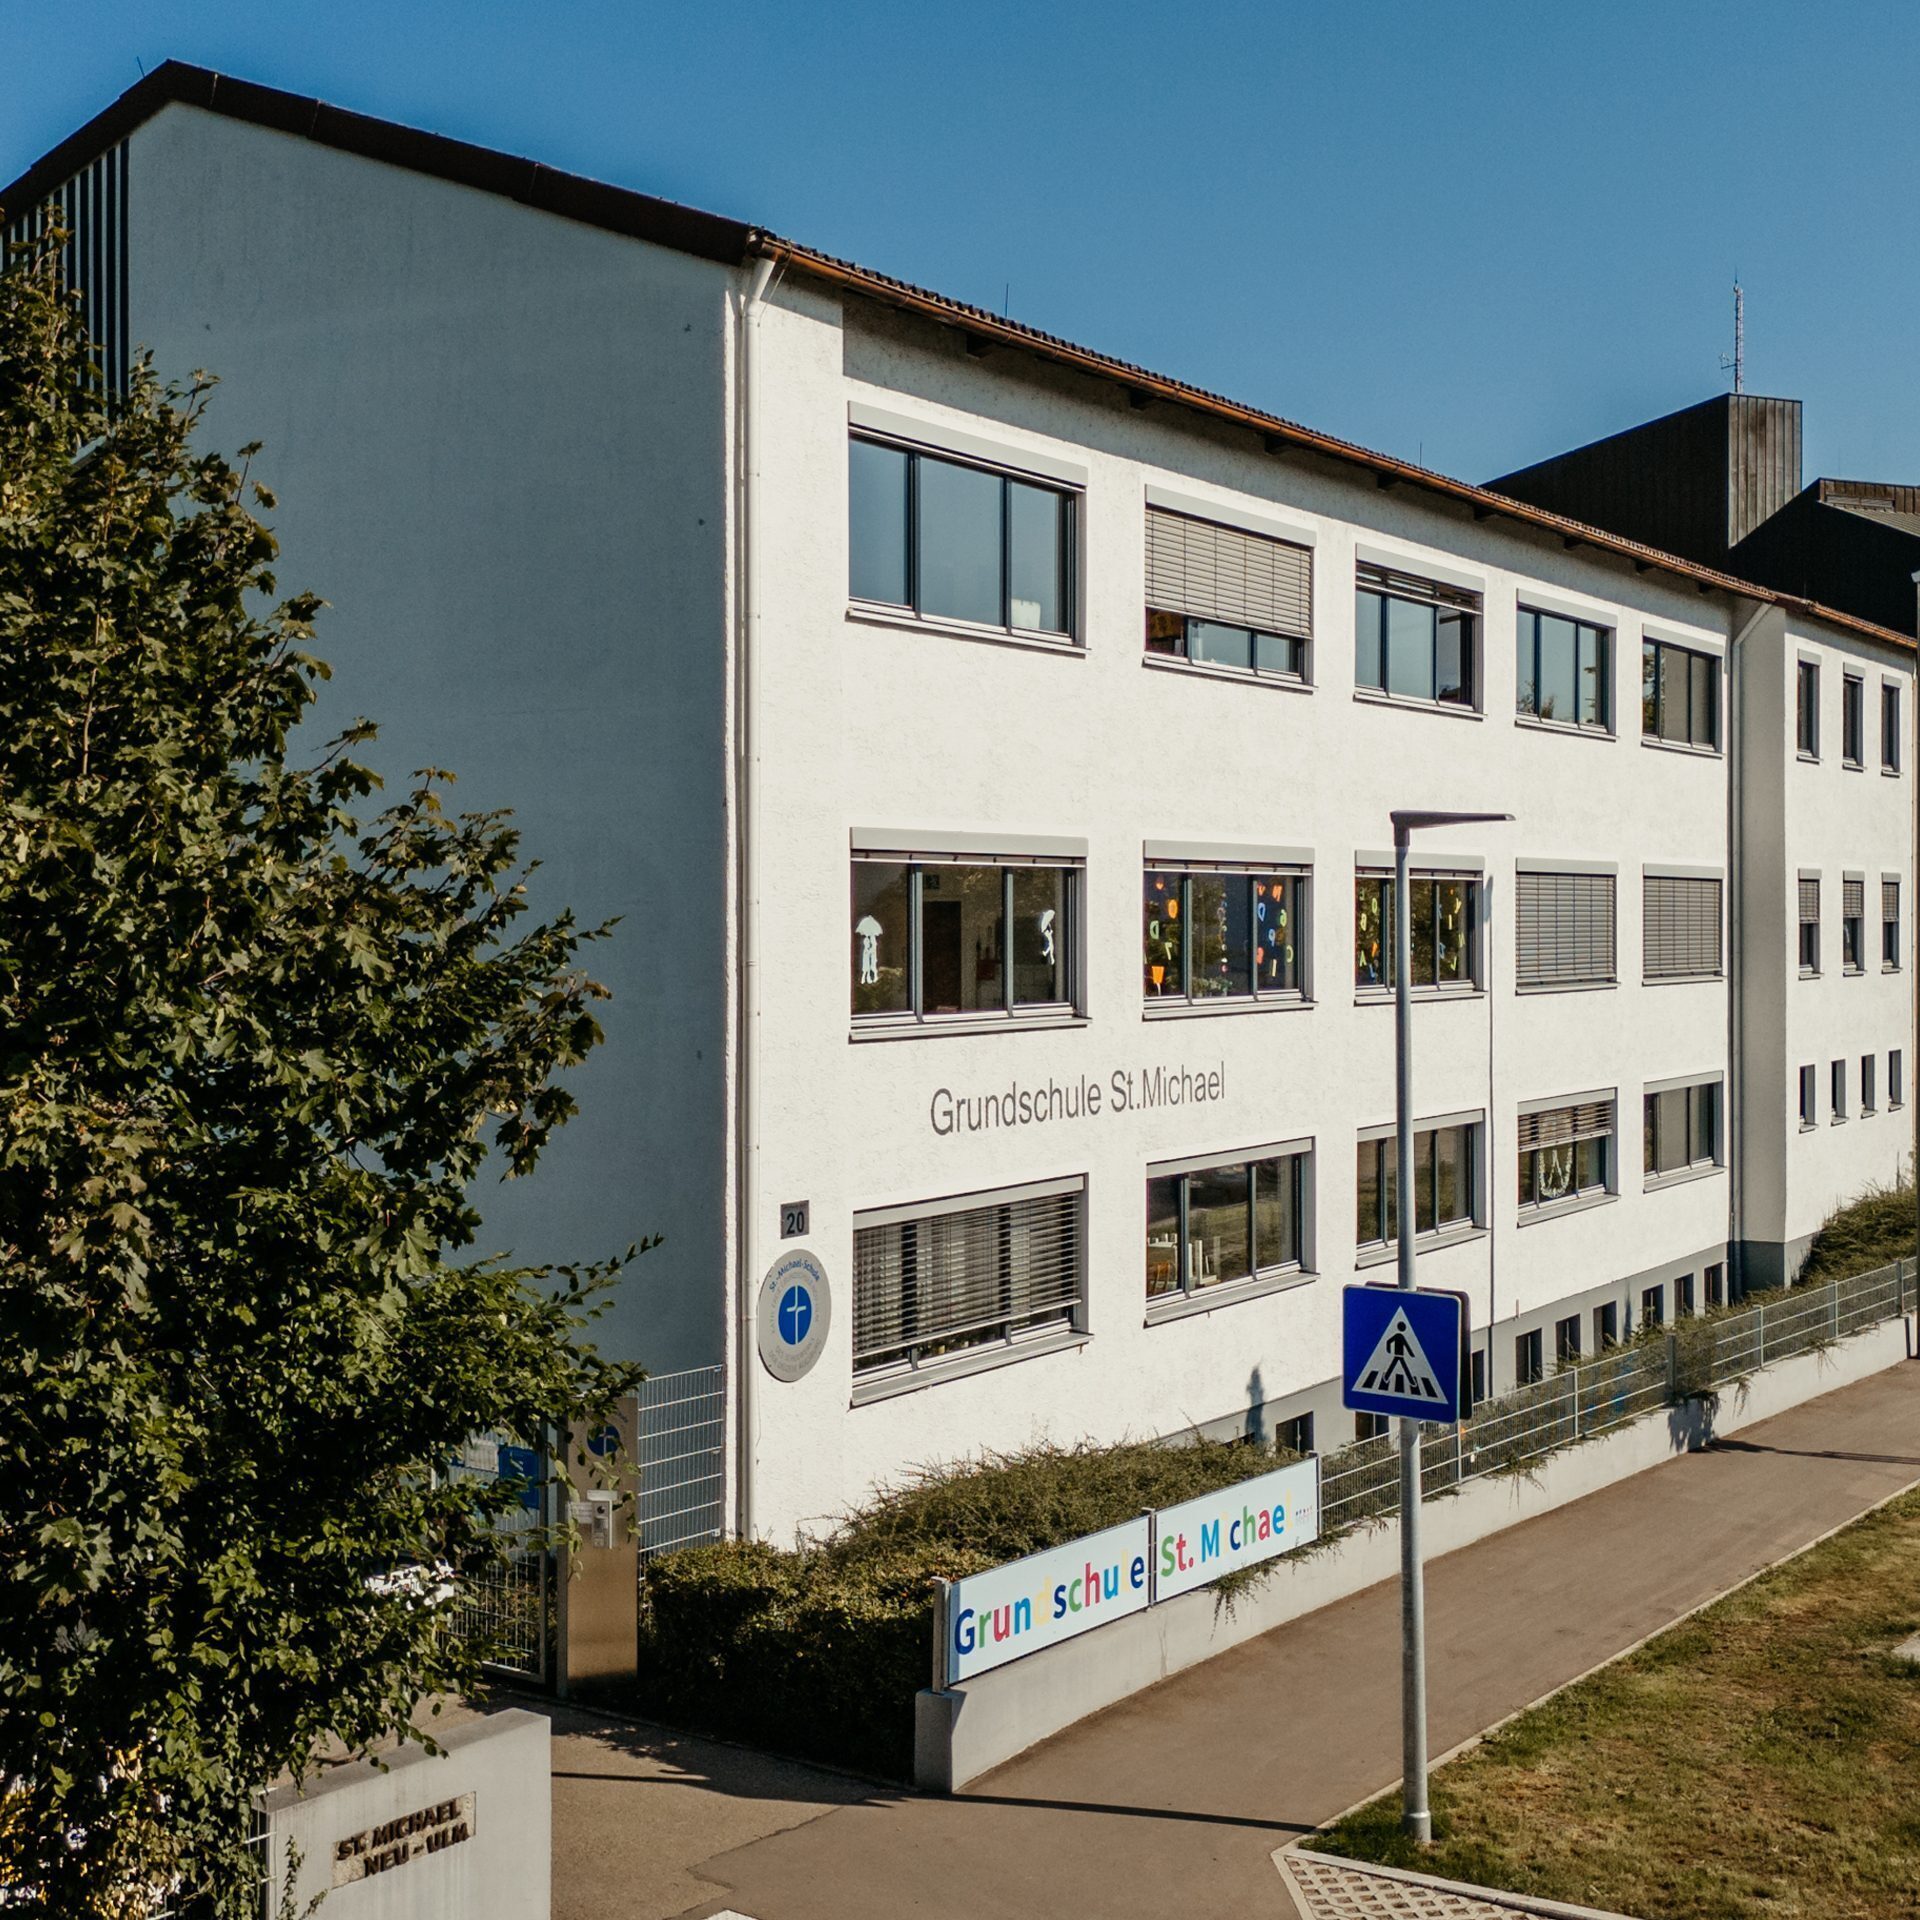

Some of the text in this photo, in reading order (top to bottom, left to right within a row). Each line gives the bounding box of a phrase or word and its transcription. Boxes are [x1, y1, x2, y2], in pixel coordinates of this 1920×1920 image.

[930, 1073, 1102, 1136] Grundschule
[786, 1211, 805, 1235] 20
[954, 1488, 1294, 1656] Grundschule St. Michael
[371, 1799, 462, 1849] MICHAEL
